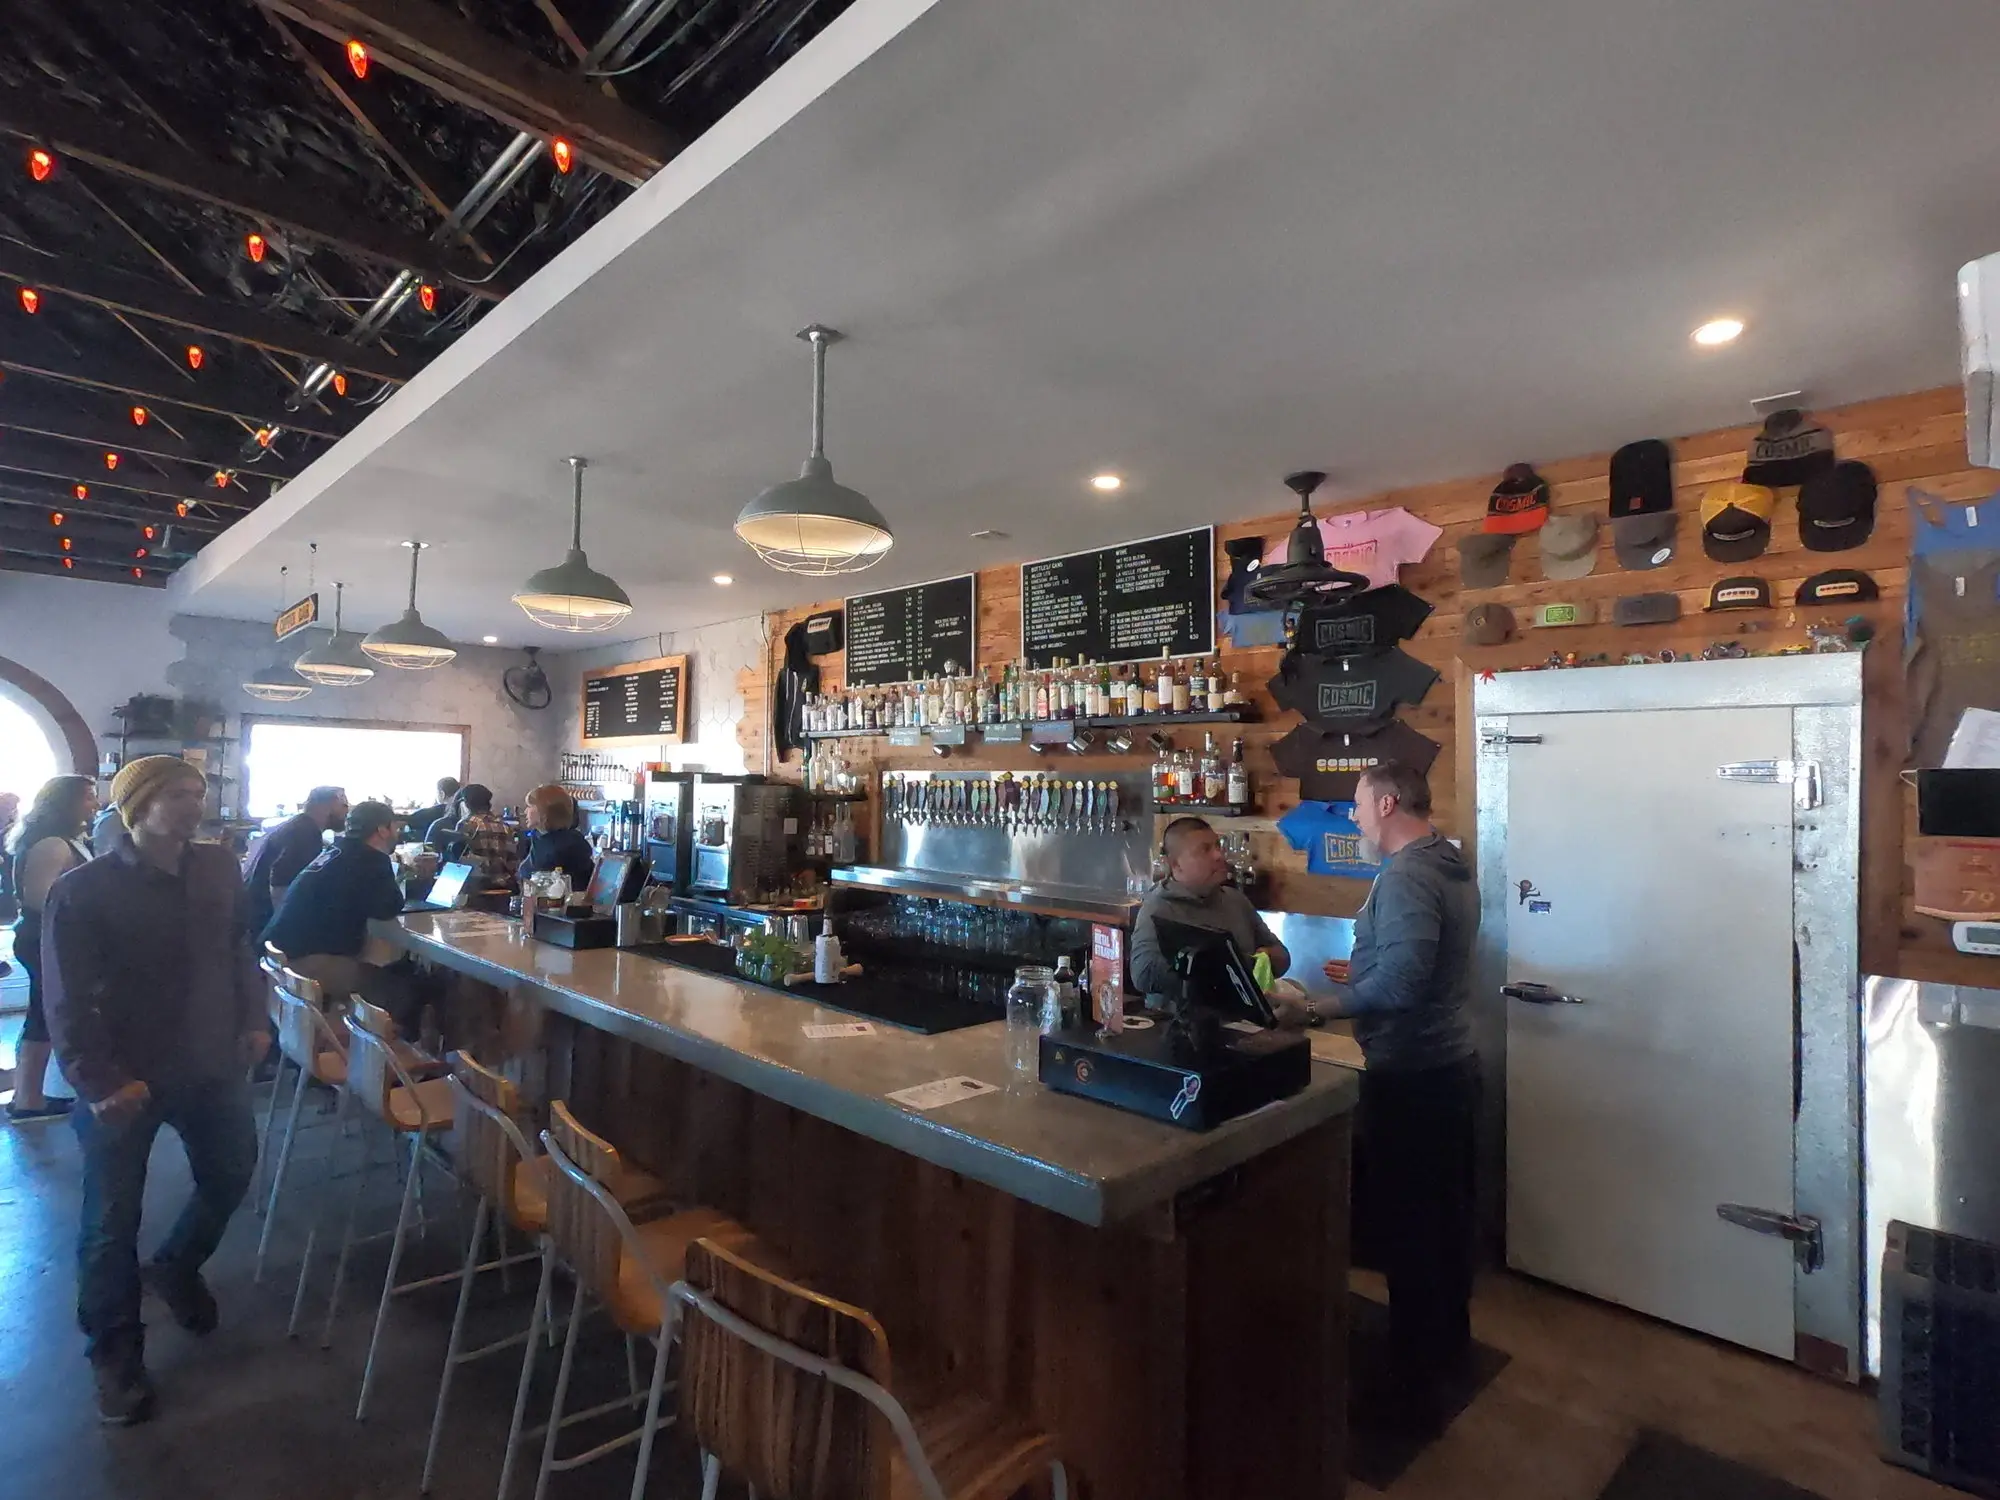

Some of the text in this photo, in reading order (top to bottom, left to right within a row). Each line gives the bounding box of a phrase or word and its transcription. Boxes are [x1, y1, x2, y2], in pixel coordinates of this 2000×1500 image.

[1756, 437, 1815, 458] COSMIC
[1496, 495, 1537, 511] COSMIC
[1320, 620, 1369, 642] COSMIC
[1322, 686, 1372, 708] COSMIC
[1316, 758, 1378, 771] COSMIC
